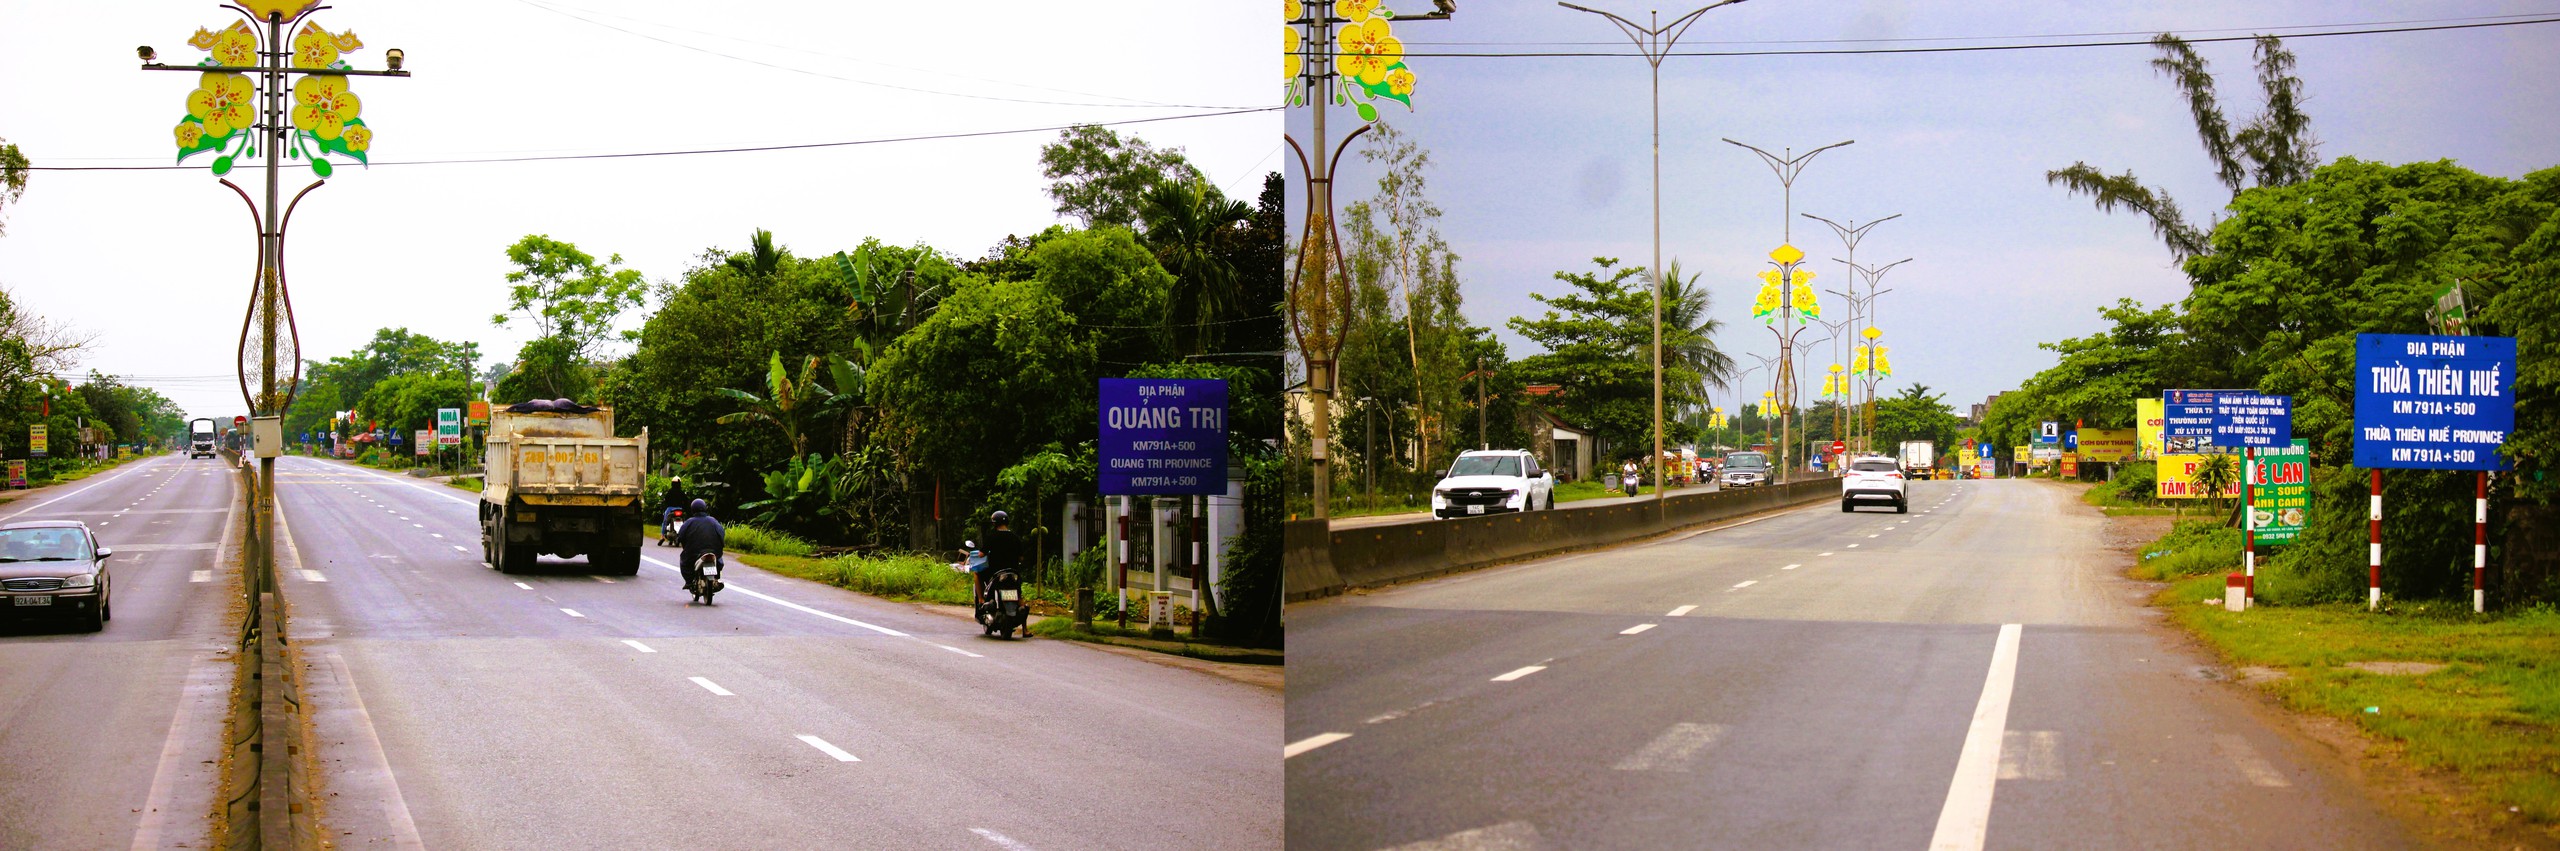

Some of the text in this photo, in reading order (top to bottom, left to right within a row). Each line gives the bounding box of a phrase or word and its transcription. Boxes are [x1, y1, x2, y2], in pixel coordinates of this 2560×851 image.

[2407, 340, 2464, 358] ĐỊA PHẬN
[2372, 360, 2501, 396] THỪA THIÊN HUẾ
[1139, 384, 1184, 398] ĐỊA PHẬN
[2394, 400, 2412, 414] KM
[441, 410, 457, 421] NHÀ
[1108, 398, 1222, 433] QUẢNG TRỊ
[440, 422, 458, 434] NGHỈ
[2364, 424, 2504, 444] THỪA THIÊN HUẾ PROVINCE
[1133, 441, 1196, 451] KM791A+500
[2392, 448, 2410, 462] KM
[1111, 458, 1212, 468] QUANG TRI PROVINCE
[2272, 462, 2304, 484] LAN
[1132, 476, 1197, 487] KM791A+500
[2254, 488, 2264, 496] UI
[2278, 486, 2304, 495] SOUP
[2254, 498, 2305, 508] ÁNH CANH
